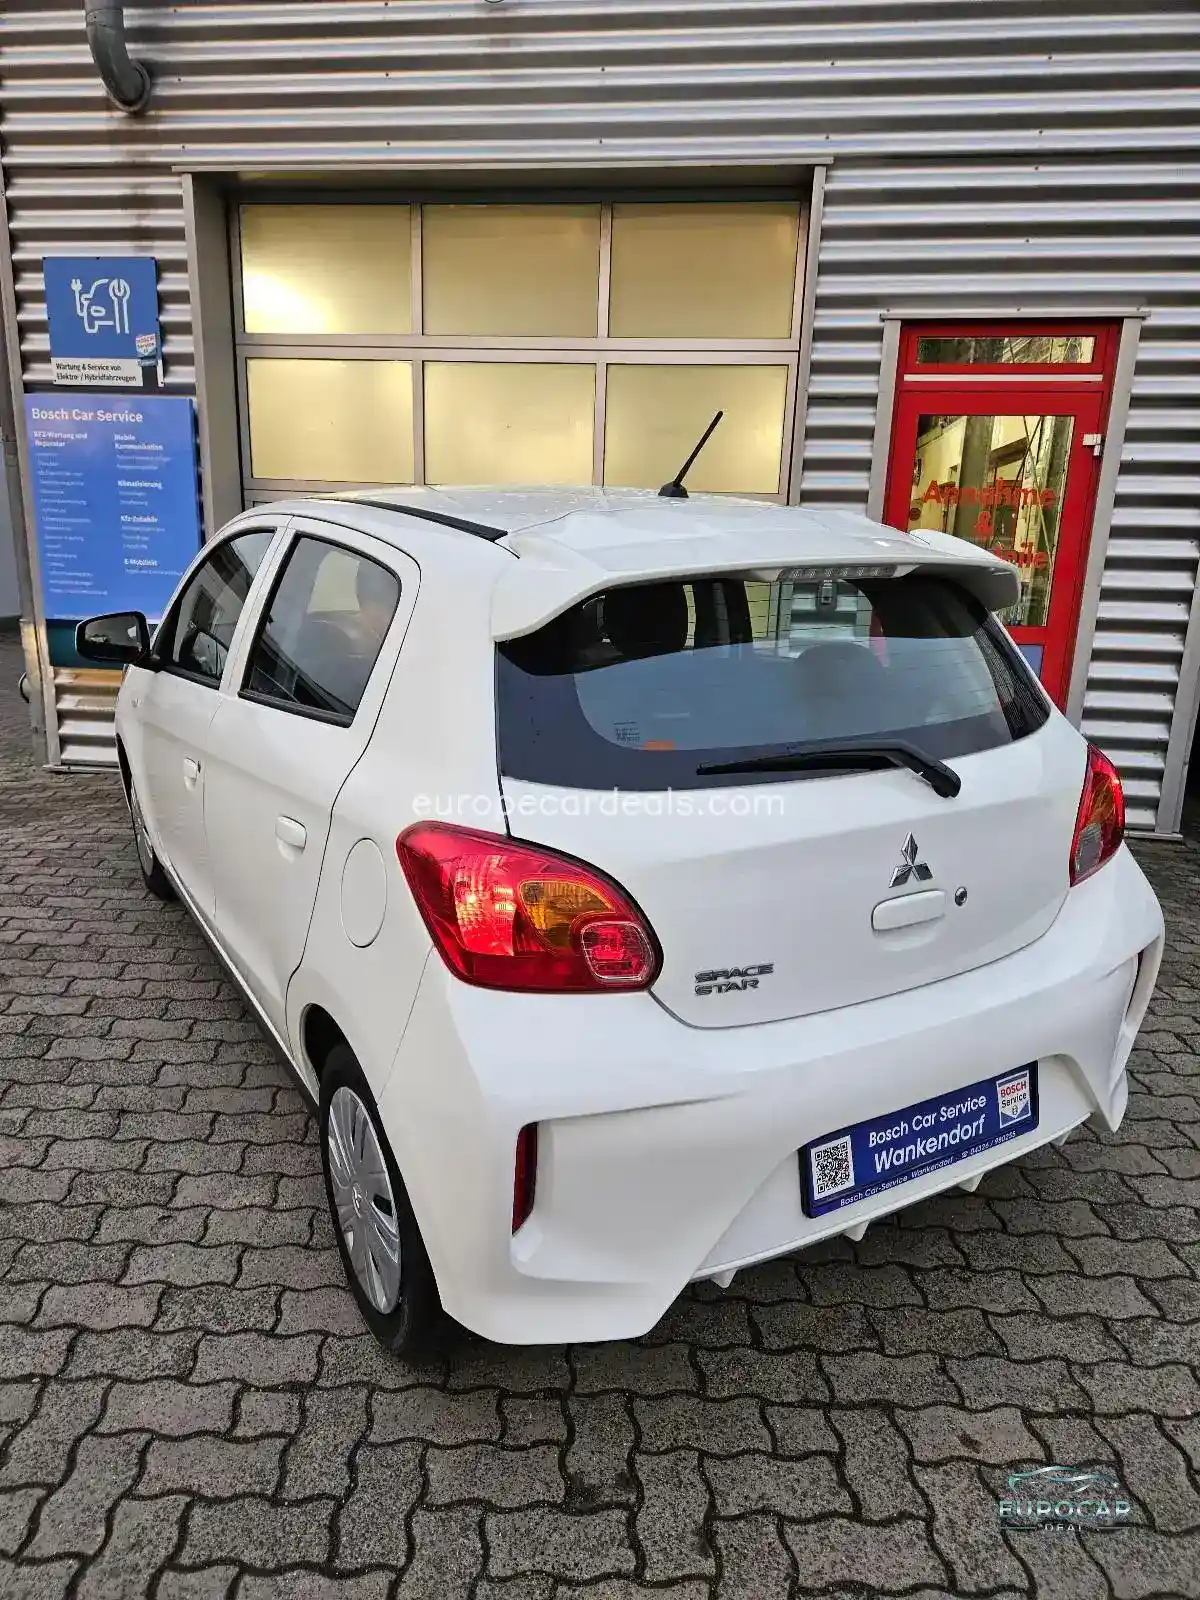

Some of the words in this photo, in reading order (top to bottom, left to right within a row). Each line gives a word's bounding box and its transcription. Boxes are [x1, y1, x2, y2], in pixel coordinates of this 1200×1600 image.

[56, 363, 80, 371] Wartung
[87, 363, 109, 371] Service
[85, 373, 137, 382] Hybridfahrzeugen
[31, 408, 69, 420] Bosch
[72, 409, 94, 421] Car
[97, 410, 144, 422] Service
[695, 963, 774, 984] SPACE
[694, 978, 760, 996] STAR
[1000, 1081, 1027, 1098] BOSCH
[1001, 1092, 1027, 1109] Service
[868, 1121, 909, 1148] Bosch
[912, 1112, 937, 1131] Car
[939, 1095, 987, 1122] Service
[874, 1113, 986, 1174] Wankendorf
[840, 1192, 863, 1207] Bosch
[911, 1155, 954, 1178] Wankendorf
